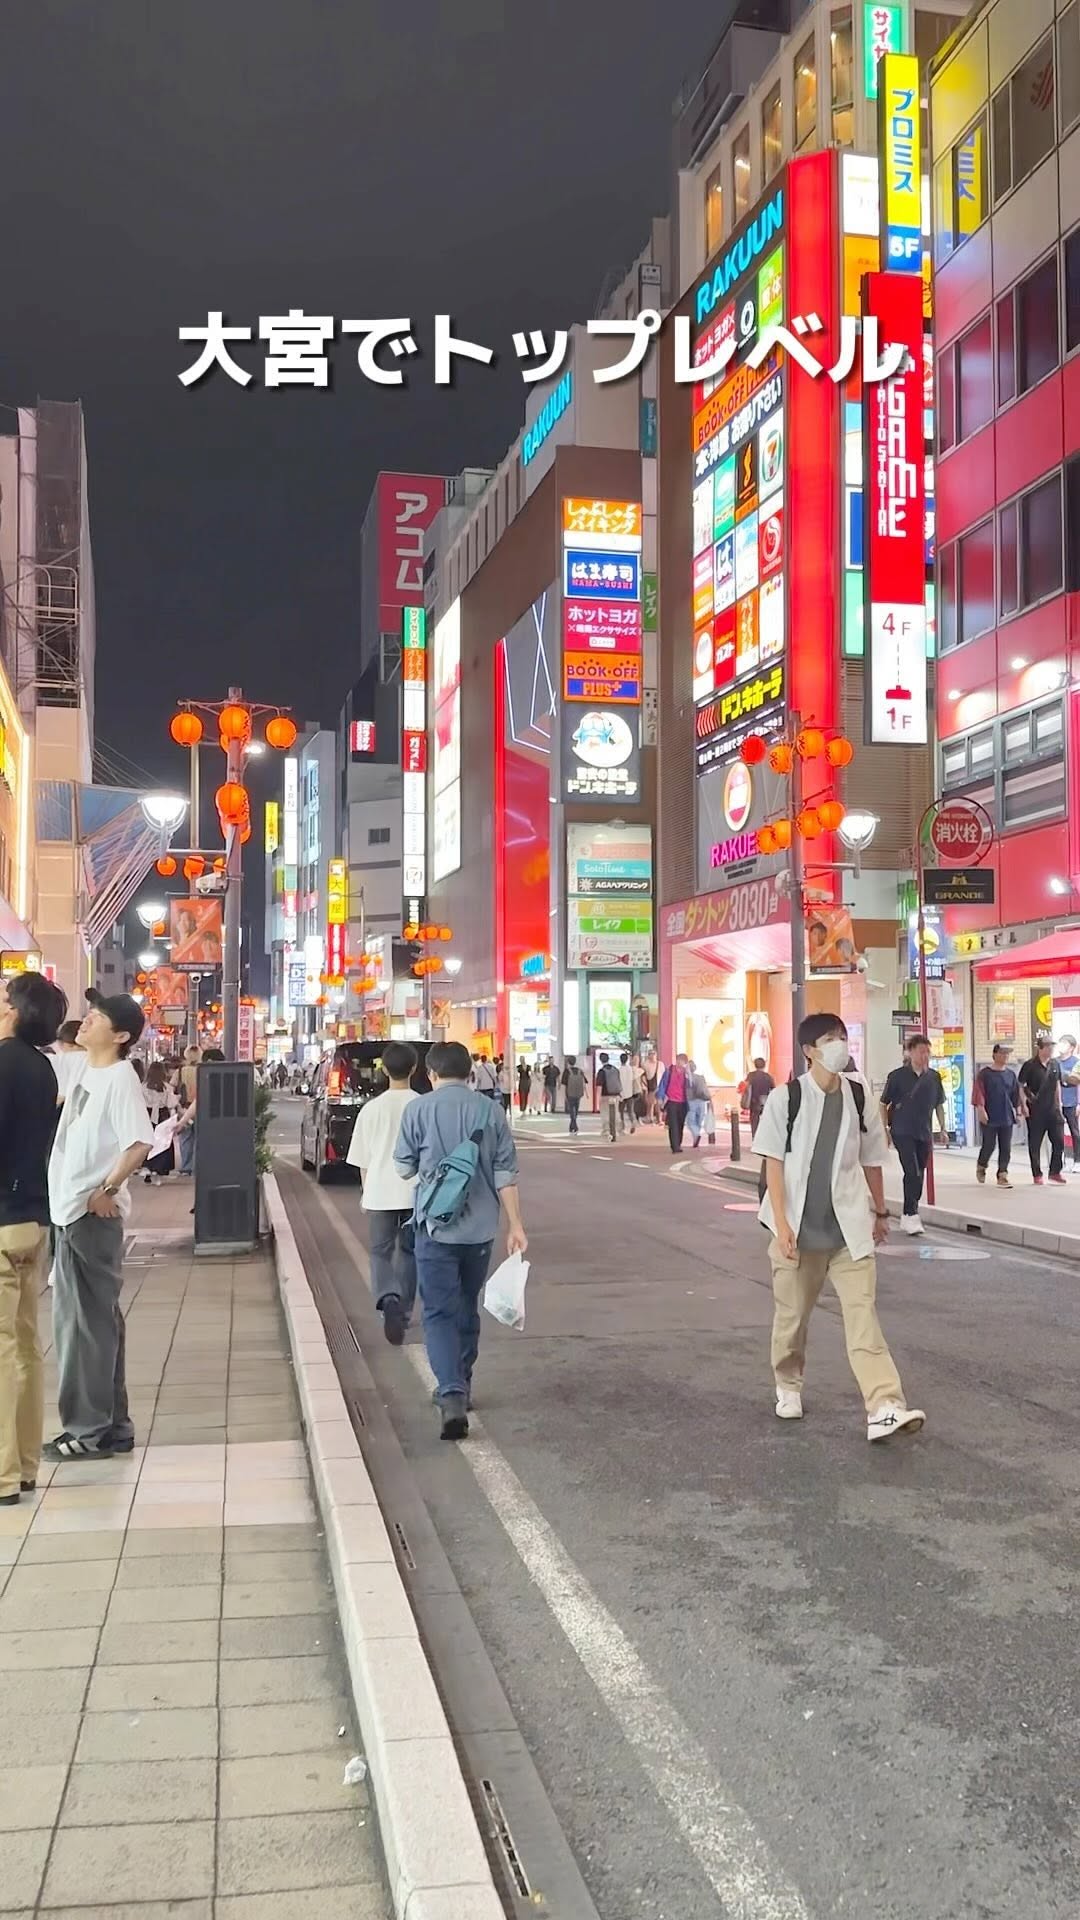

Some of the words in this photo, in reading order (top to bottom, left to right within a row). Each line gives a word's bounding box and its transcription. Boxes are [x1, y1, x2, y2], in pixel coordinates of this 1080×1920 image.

[892, 89, 915, 193] プロミス
[695, 190, 783, 324] RAKUUN
[522, 371, 572, 466] RAKUUN
[888, 377, 917, 537] GAME
[569, 517, 636, 534] バイキング
[396, 492, 428, 590] アコム
[572, 562, 633, 582] はま寿司
[645, 584, 656, 618] レイク
[568, 605, 638, 625] ホットヨガ
[881, 612, 911, 636] 4F
[886, 707, 912, 731] 1F
[409, 736, 421, 771] ガスト
[936, 822, 979, 844] 消火栓
[935, 891, 985, 900] GRANDE
[592, 919, 622, 931] レイク
